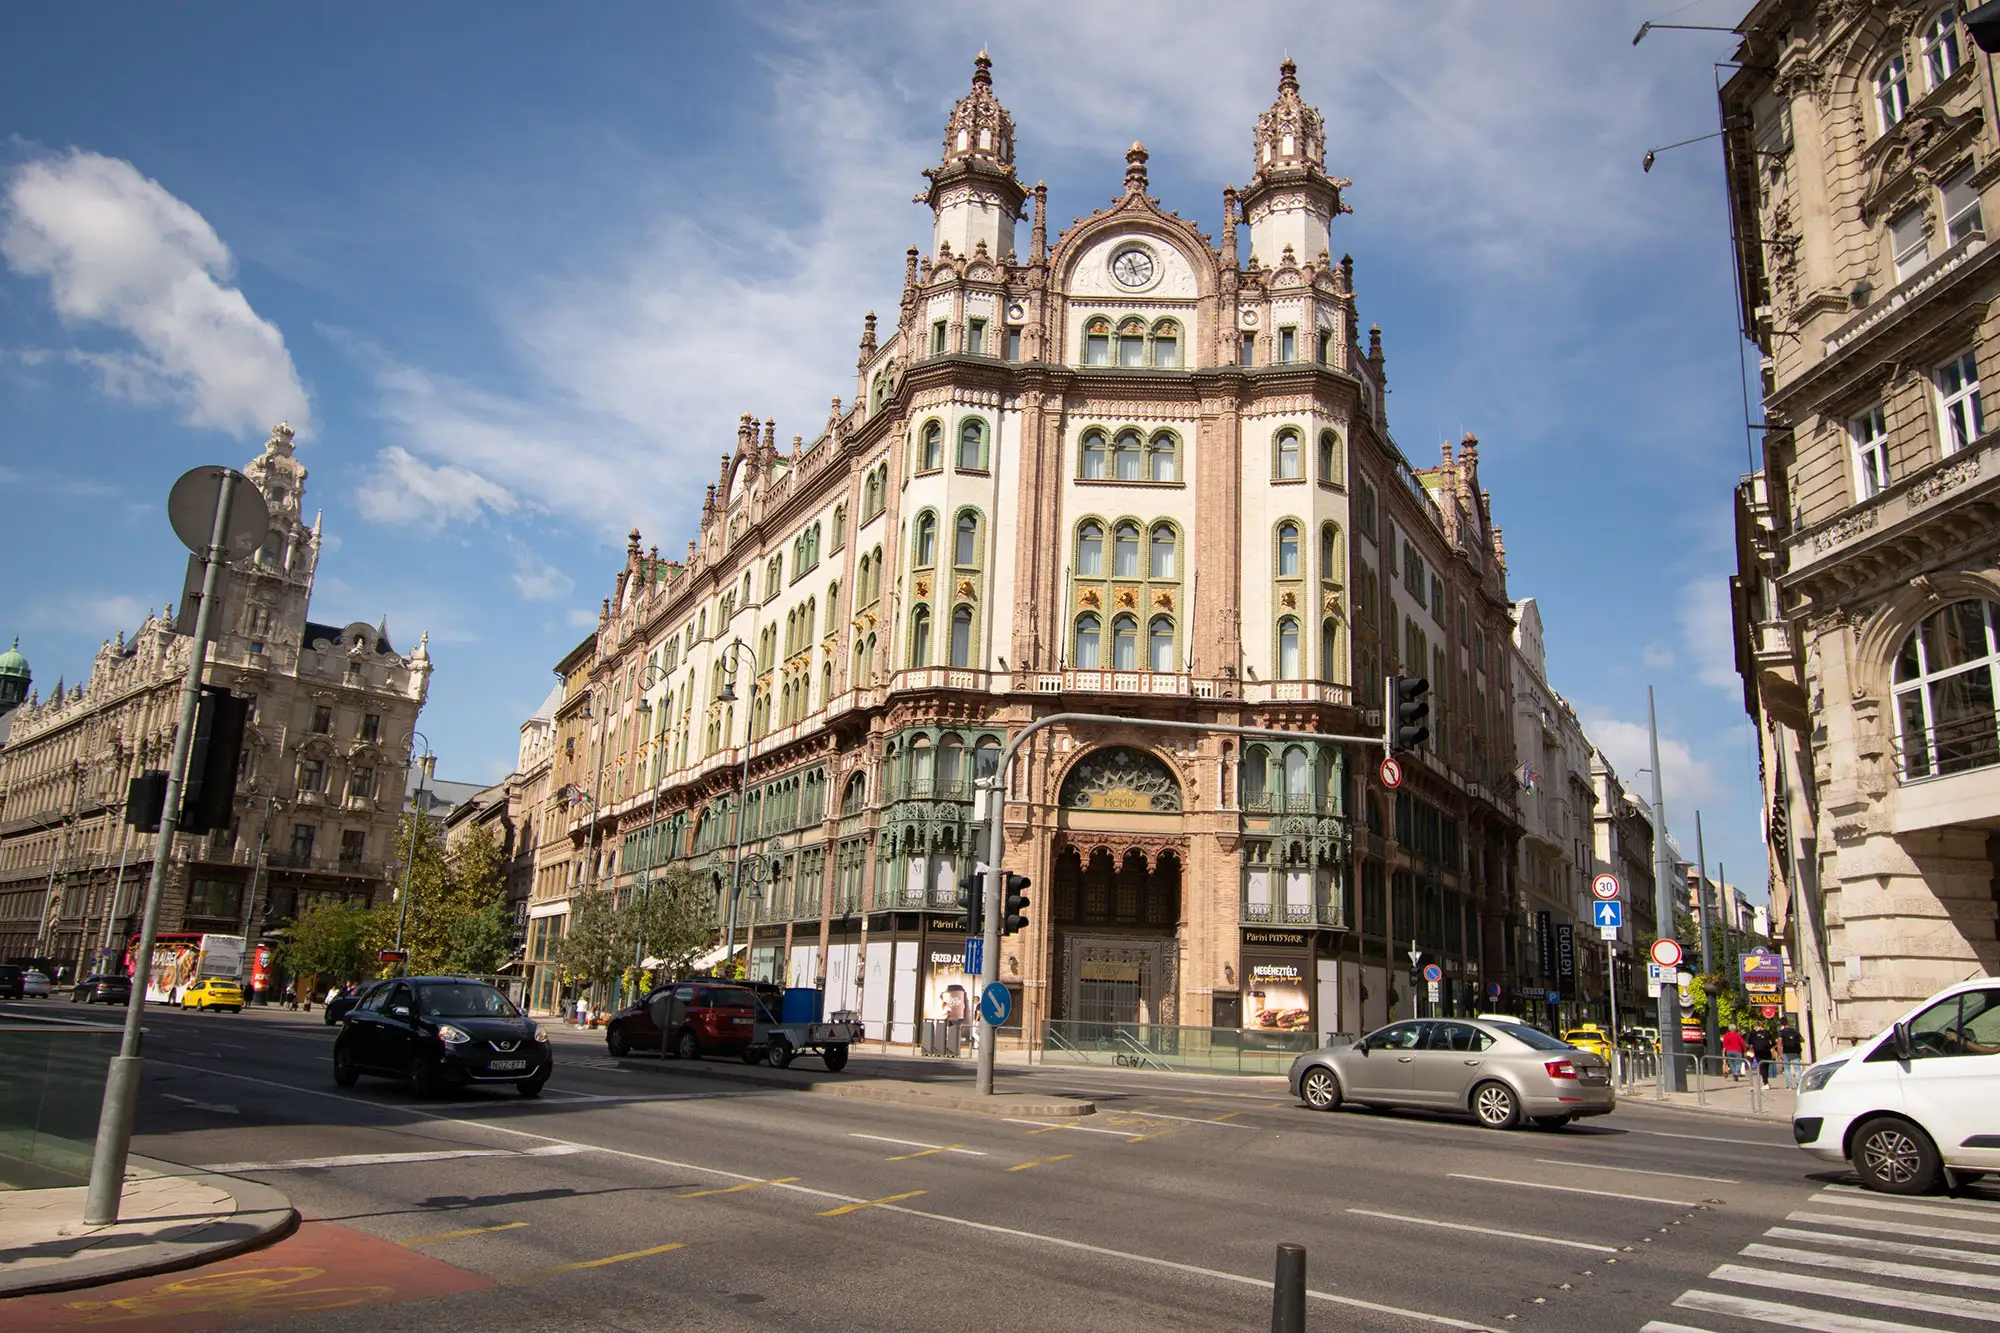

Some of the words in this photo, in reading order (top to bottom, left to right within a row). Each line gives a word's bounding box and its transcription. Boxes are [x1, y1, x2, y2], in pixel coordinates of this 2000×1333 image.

[1104, 798, 1136, 808] MCMIX
[1600, 882, 1612, 892] 30
[931, 952, 951, 962] ÉRZED
[952, 955, 960, 963] AZ
[1253, 964, 1298, 977] MEGÉHEZTÉL?
[255, 973, 270, 981] KFC
[1752, 995, 1783, 1003] CHANGE
